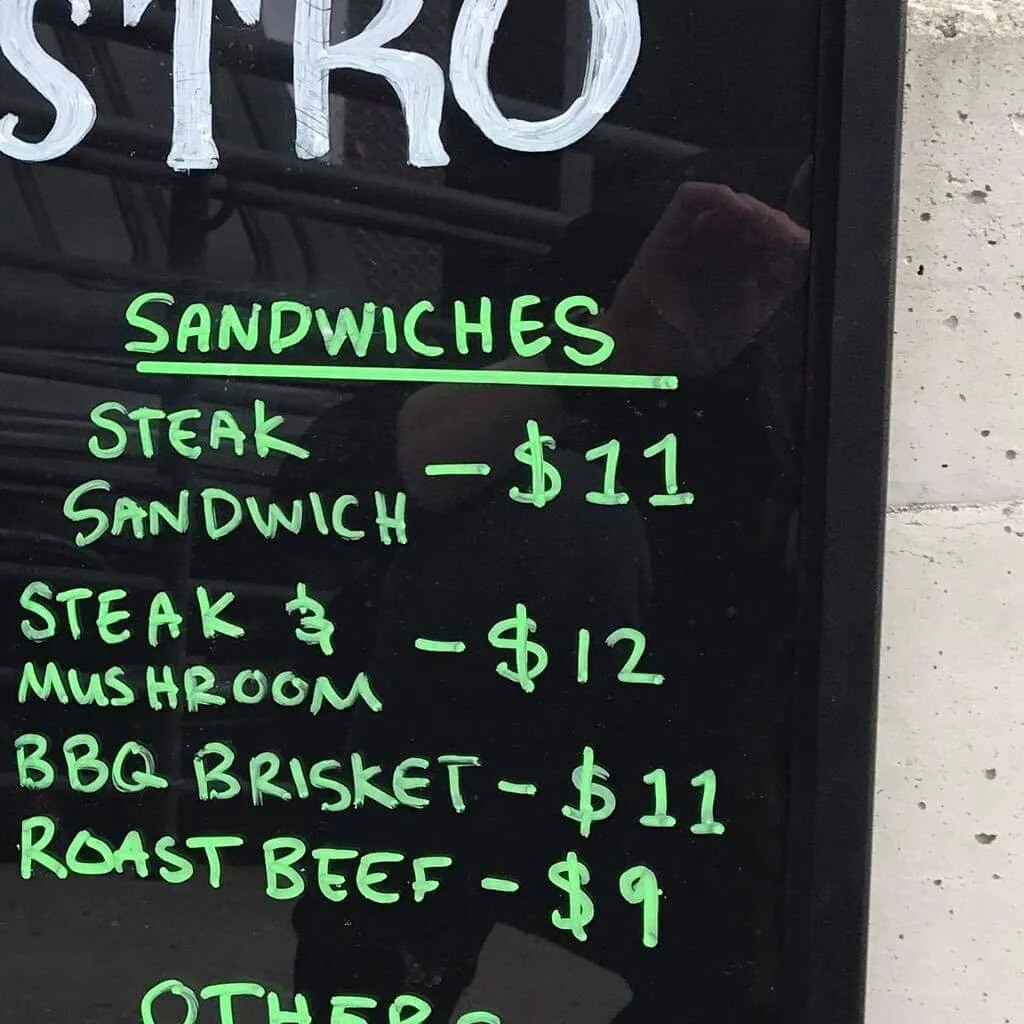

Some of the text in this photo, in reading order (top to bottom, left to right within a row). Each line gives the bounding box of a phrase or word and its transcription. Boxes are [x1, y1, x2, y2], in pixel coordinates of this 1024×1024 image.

[125, 291, 617, 367] SANDWICHES
[87, 398, 311, 460] STEAK
[508, 419, 695, 509] $11
[62, 480, 409, 546] SANDWICH
[19, 580, 245, 647] STEAK
[487, 602, 666, 694] $12
[17, 661, 384, 715] MUSHROOM
[14, 733, 169, 794] BBQ
[192, 741, 482, 813] BRISKET
[560, 745, 727, 837] $11
[18, 814, 244, 890] ROAST
[263, 836, 454, 904] BEEF
[547, 851, 664, 950] $9
